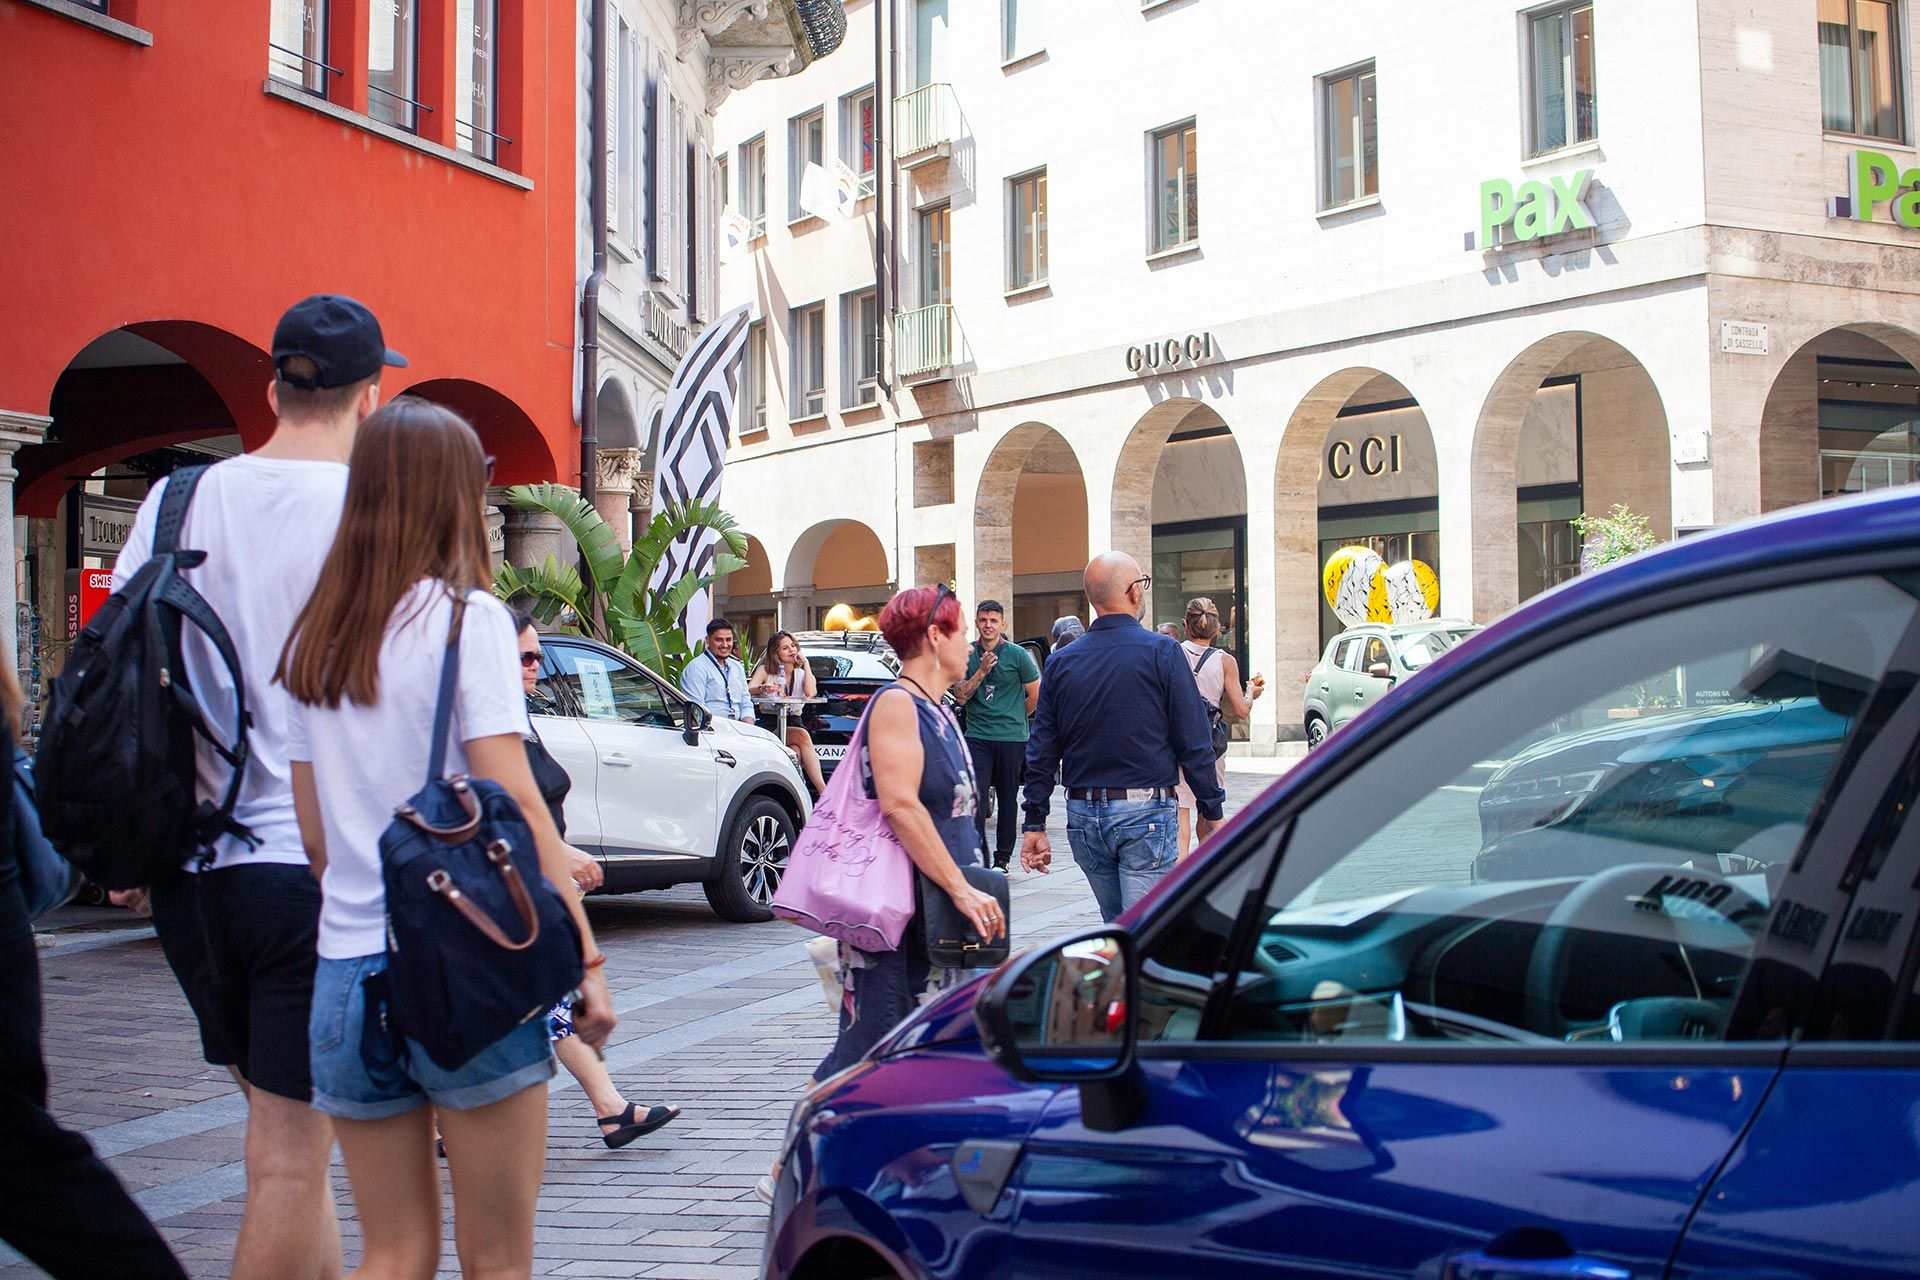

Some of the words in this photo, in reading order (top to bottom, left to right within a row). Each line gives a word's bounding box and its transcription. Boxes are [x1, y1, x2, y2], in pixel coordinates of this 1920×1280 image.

[1480, 169, 1597, 249] Pax
[1731, 325, 1759, 336] CONTRADA
[1126, 331, 1211, 372] GUCCI
[1328, 435, 1400, 479] CCI
[92, 516, 131, 544] TOURB
[90, 573, 113, 588] SWIS
[68, 594, 78, 640] SSLOS
[815, 748, 847, 757] KANA
